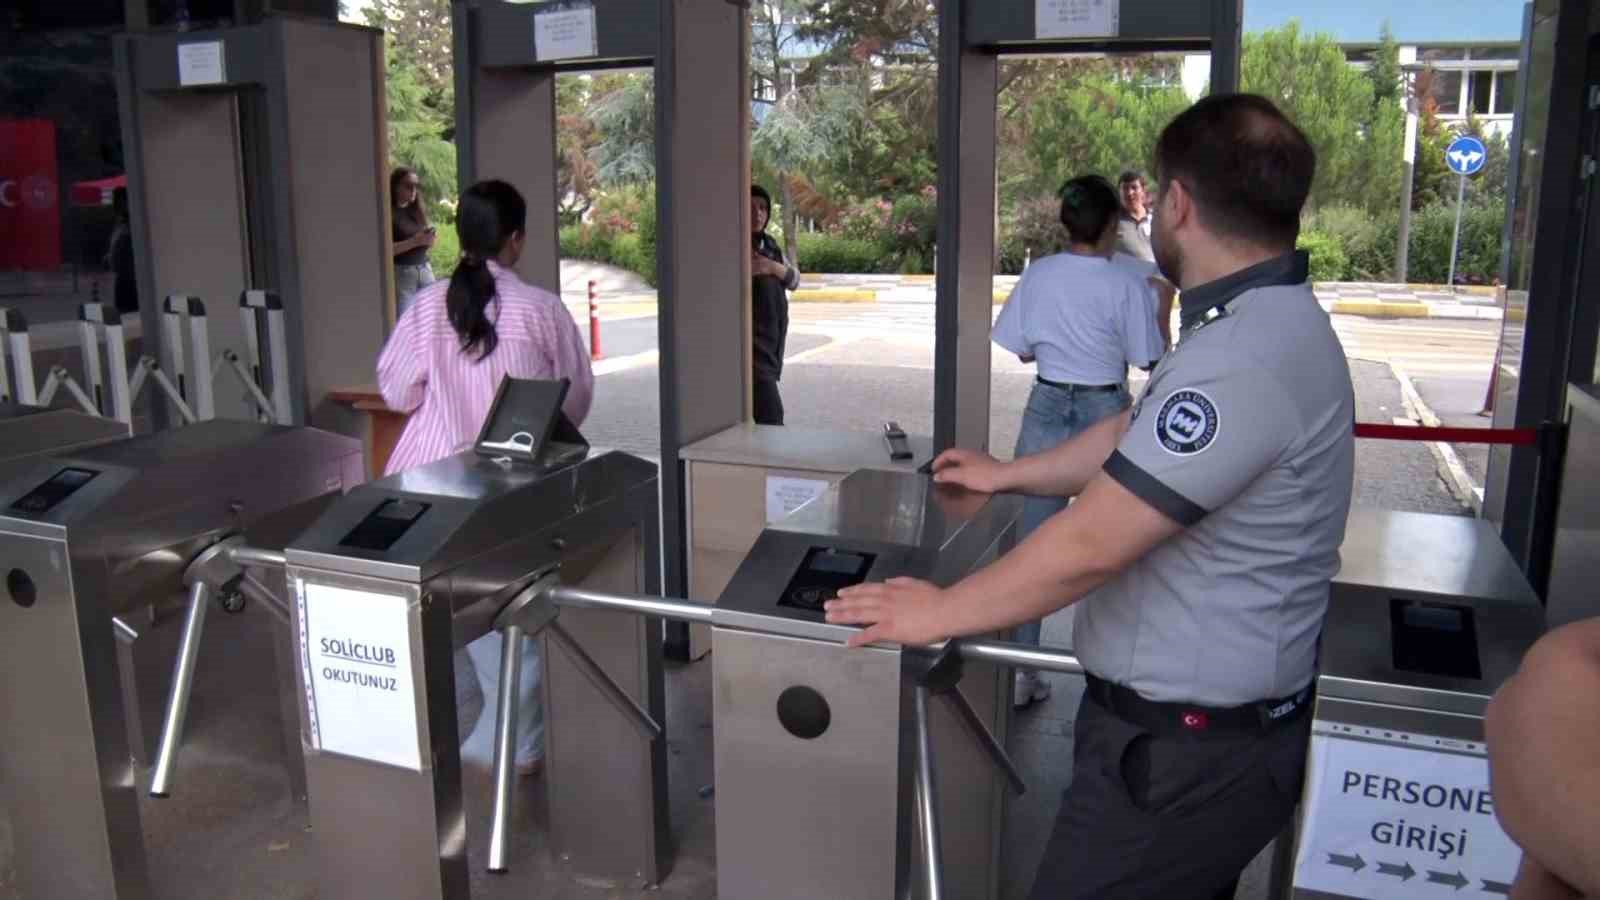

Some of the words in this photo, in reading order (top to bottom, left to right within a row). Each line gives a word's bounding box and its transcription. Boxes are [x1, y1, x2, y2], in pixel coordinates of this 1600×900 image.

[320, 637, 396, 665] SOLİCLUB
[322, 666, 399, 692] OKUTUNUZ
[1342, 770, 1493, 815] PERSONE
[1370, 819, 1468, 860] GİRİŞİ
